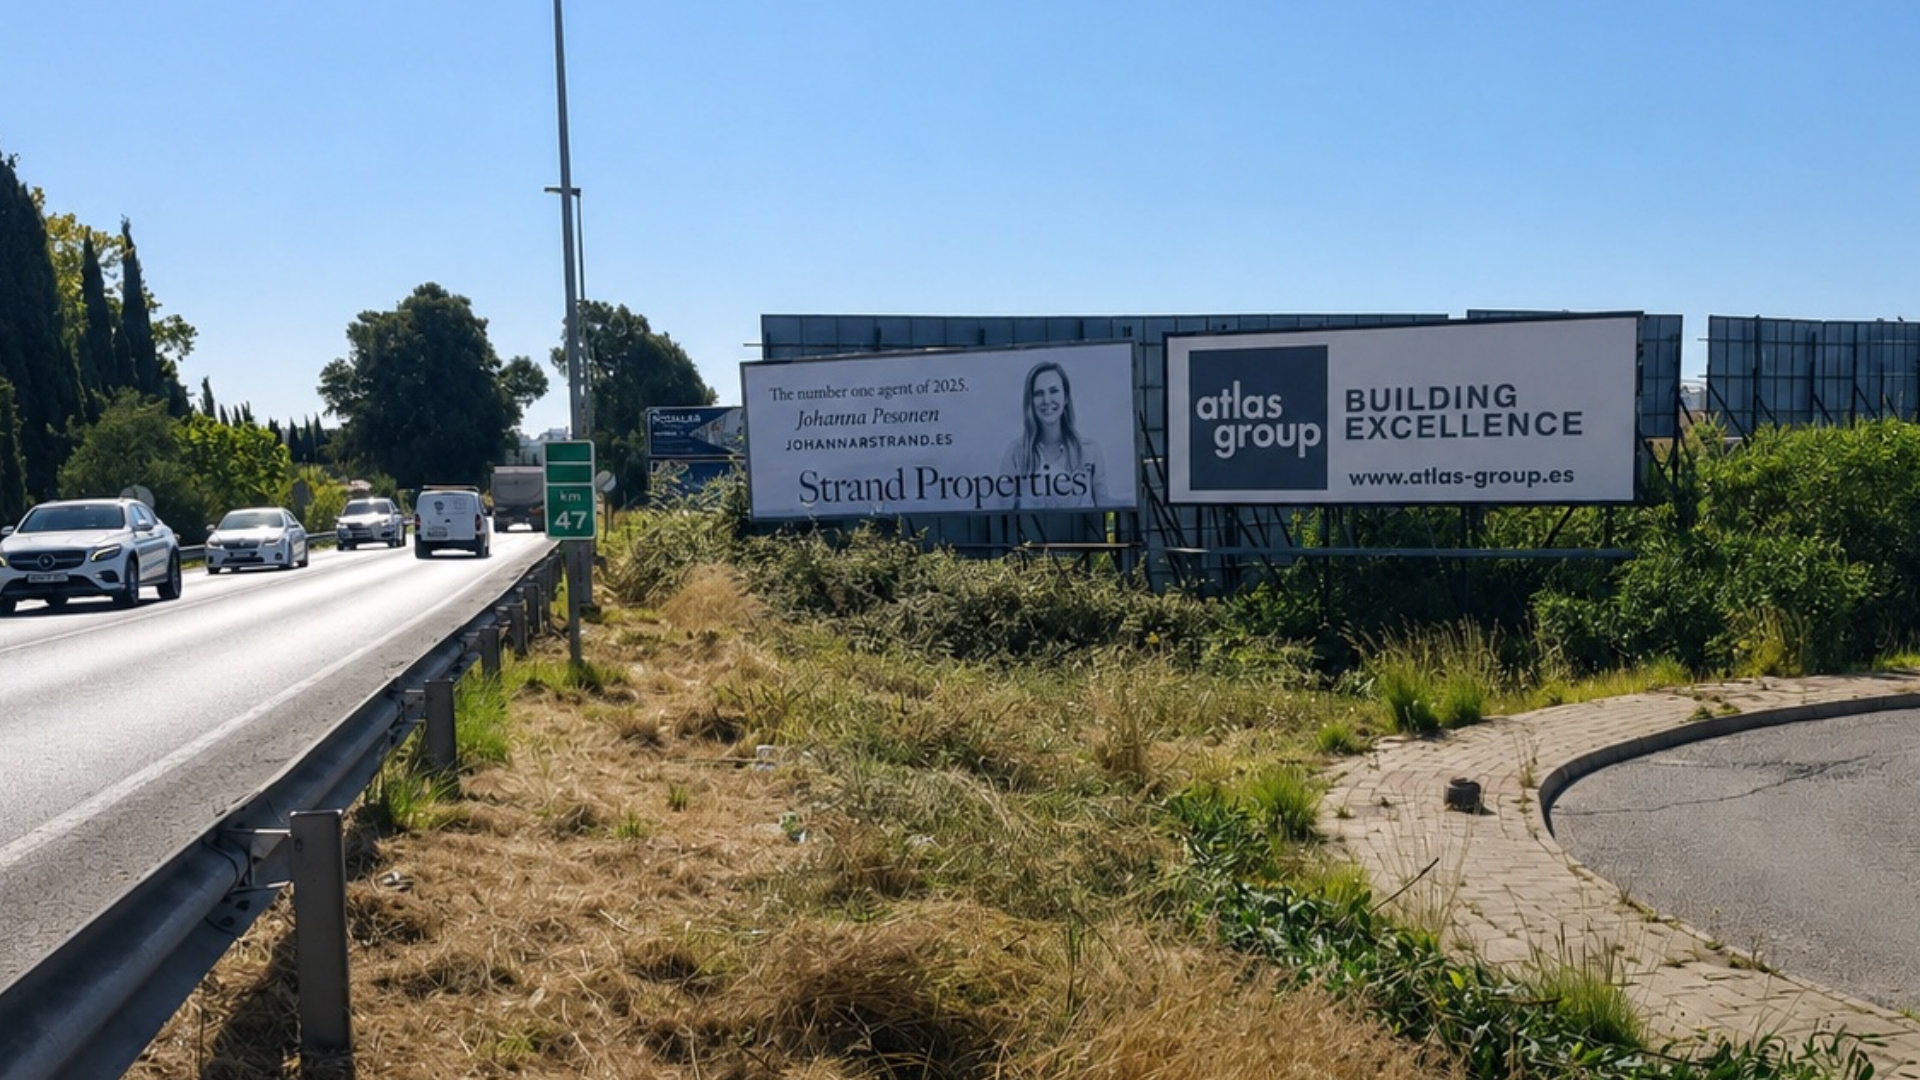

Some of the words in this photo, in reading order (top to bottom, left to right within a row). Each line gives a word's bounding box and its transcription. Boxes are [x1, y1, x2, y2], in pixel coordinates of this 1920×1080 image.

[769, 387, 794, 402] The
[797, 384, 847, 400] number
[850, 385, 875, 398] one
[877, 383, 913, 400] agent
[916, 378, 930, 395] of
[933, 377, 969, 394] 2025.
[1196, 380, 1283, 420] atlas
[1345, 383, 1518, 413] BUILDING
[795, 409, 867, 431] Johanna
[872, 407, 940, 424] Pesonen
[1345, 411, 1584, 440] EXCELLENCE
[1213, 420, 1322, 459] group
[799, 467, 906, 503] Strand
[1349, 466, 1575, 489] www.atlas-group.es
[560, 490, 581, 501] km
[554, 510, 588, 530] 47
